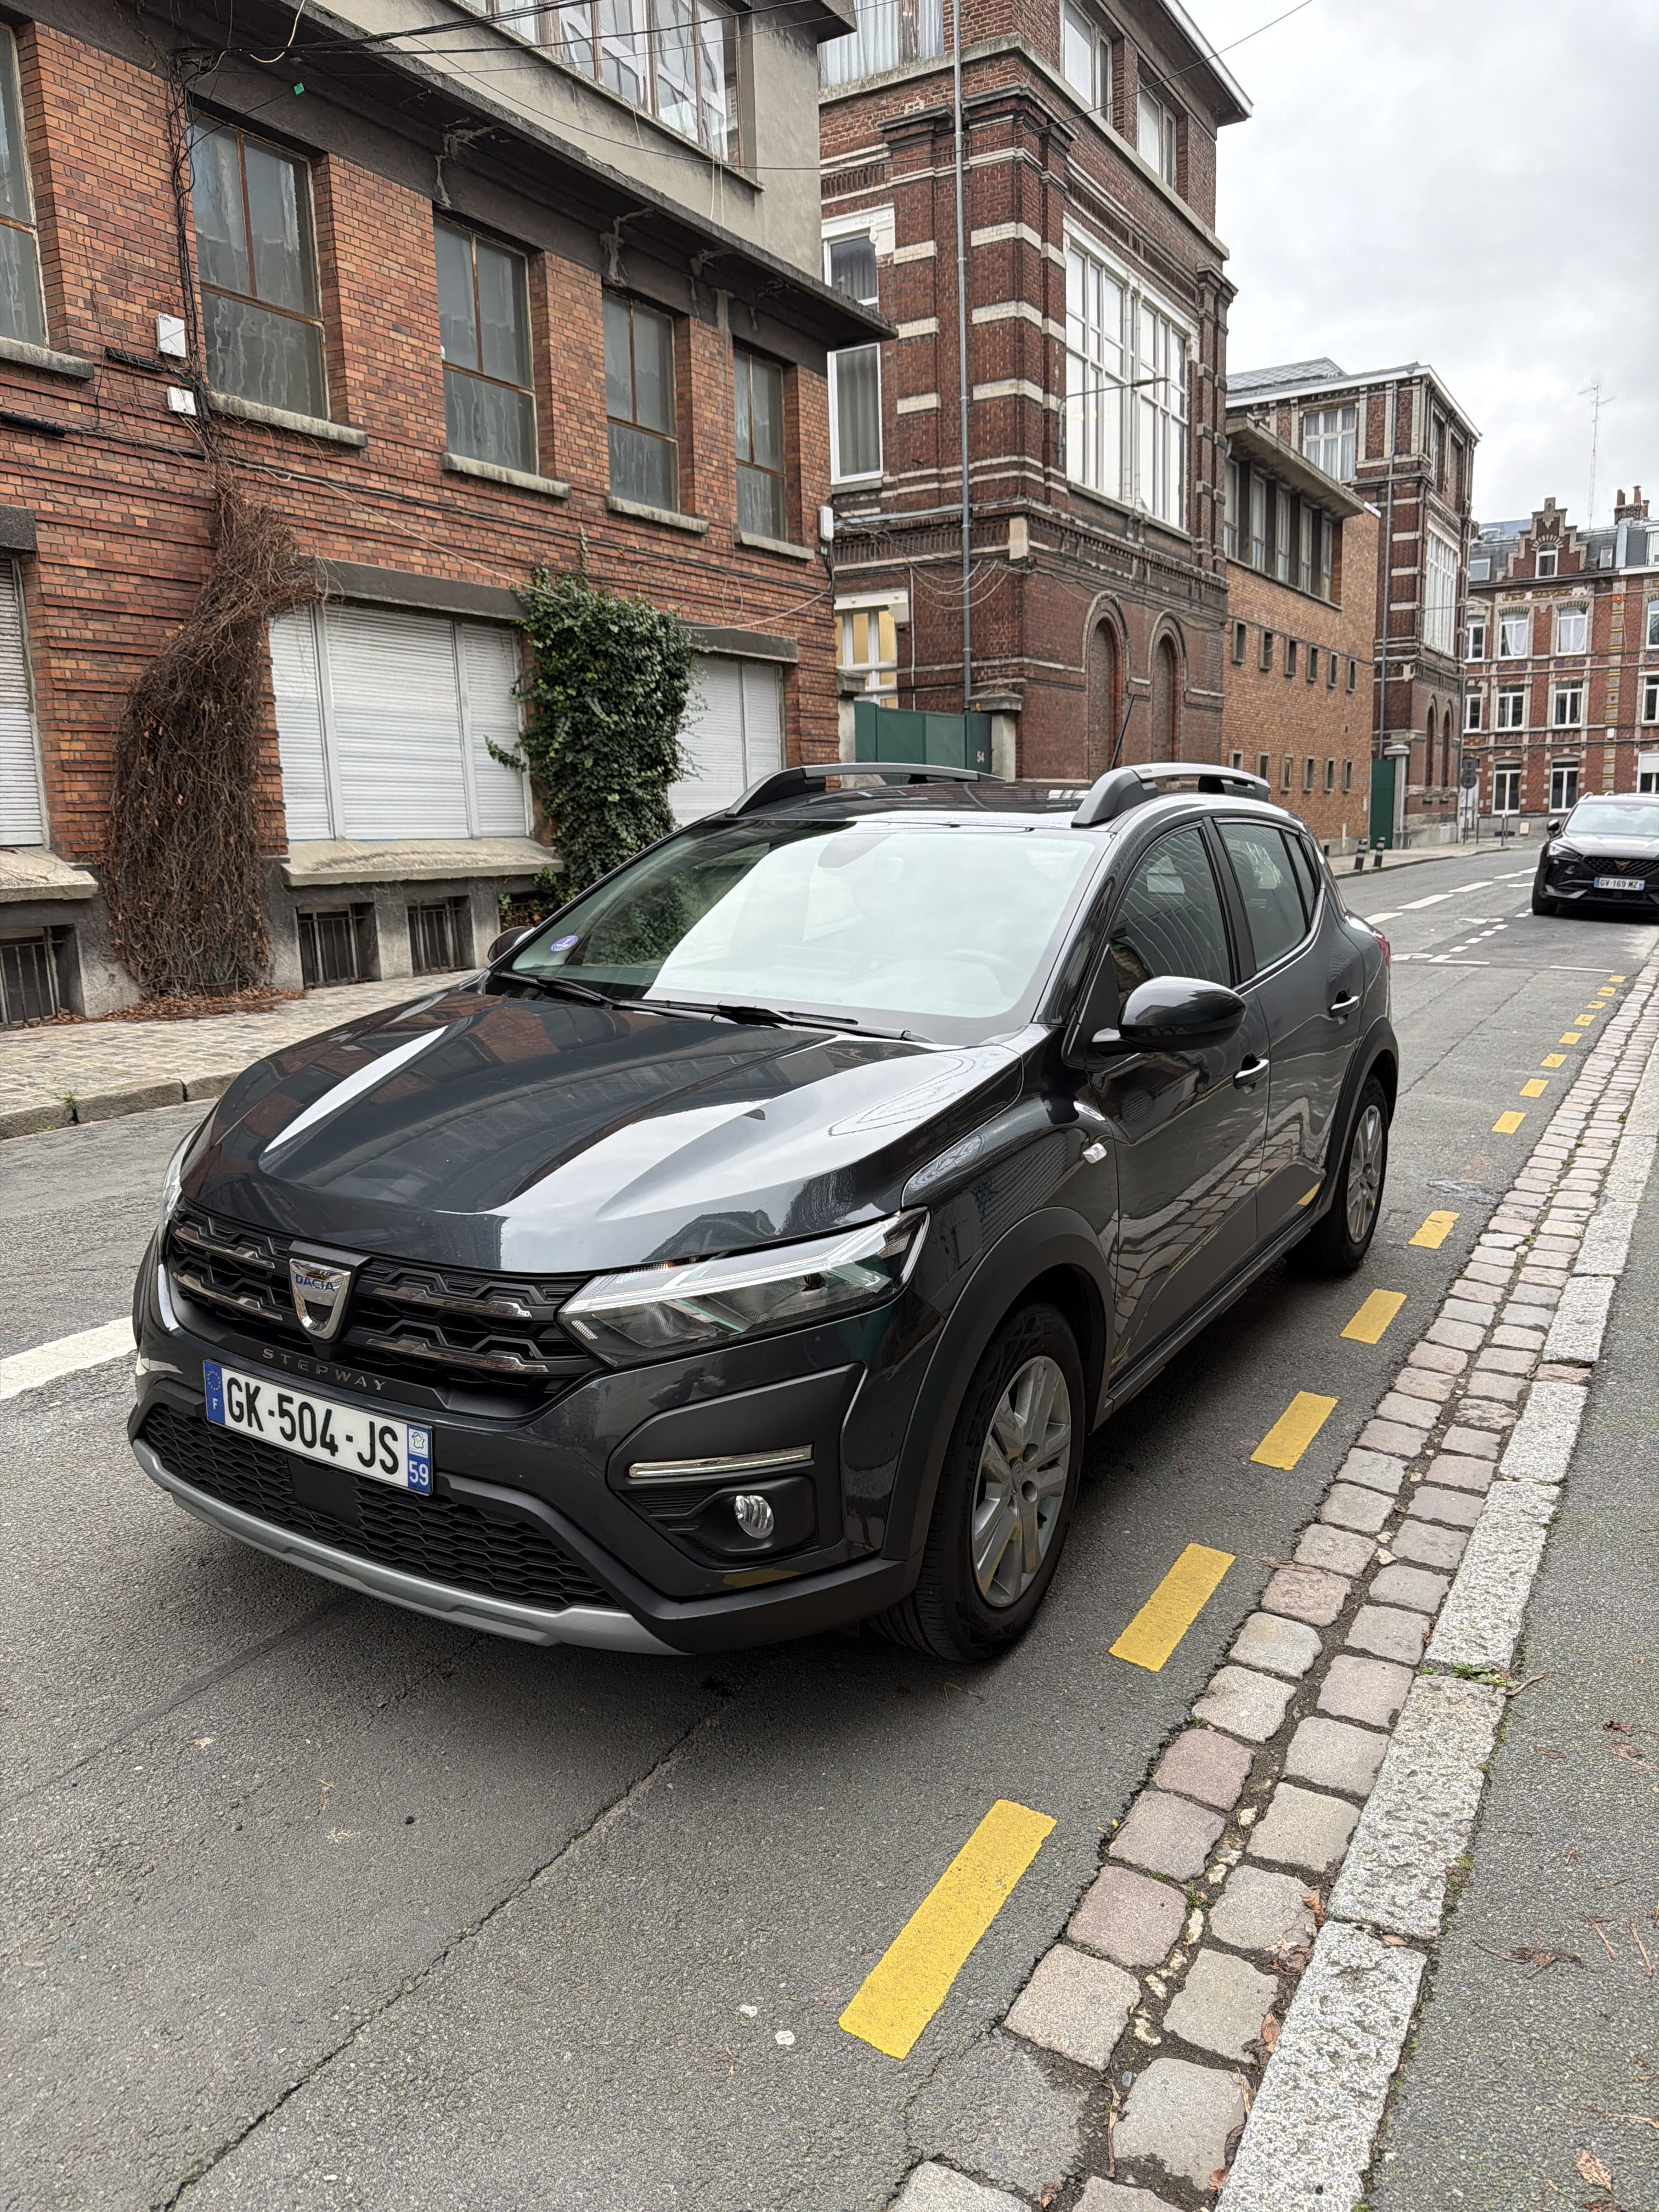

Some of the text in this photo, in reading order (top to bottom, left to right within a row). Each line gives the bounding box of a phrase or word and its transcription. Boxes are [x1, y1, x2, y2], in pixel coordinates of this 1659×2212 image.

[977, 751, 985, 763] 54
[295, 1273, 335, 1292] DACIA
[262, 1348, 387, 1391] STEPWAY
[212, 1397, 218, 1410] F
[227, 1376, 399, 1475] GK-504-JS
[409, 1460, 429, 1486] 59
